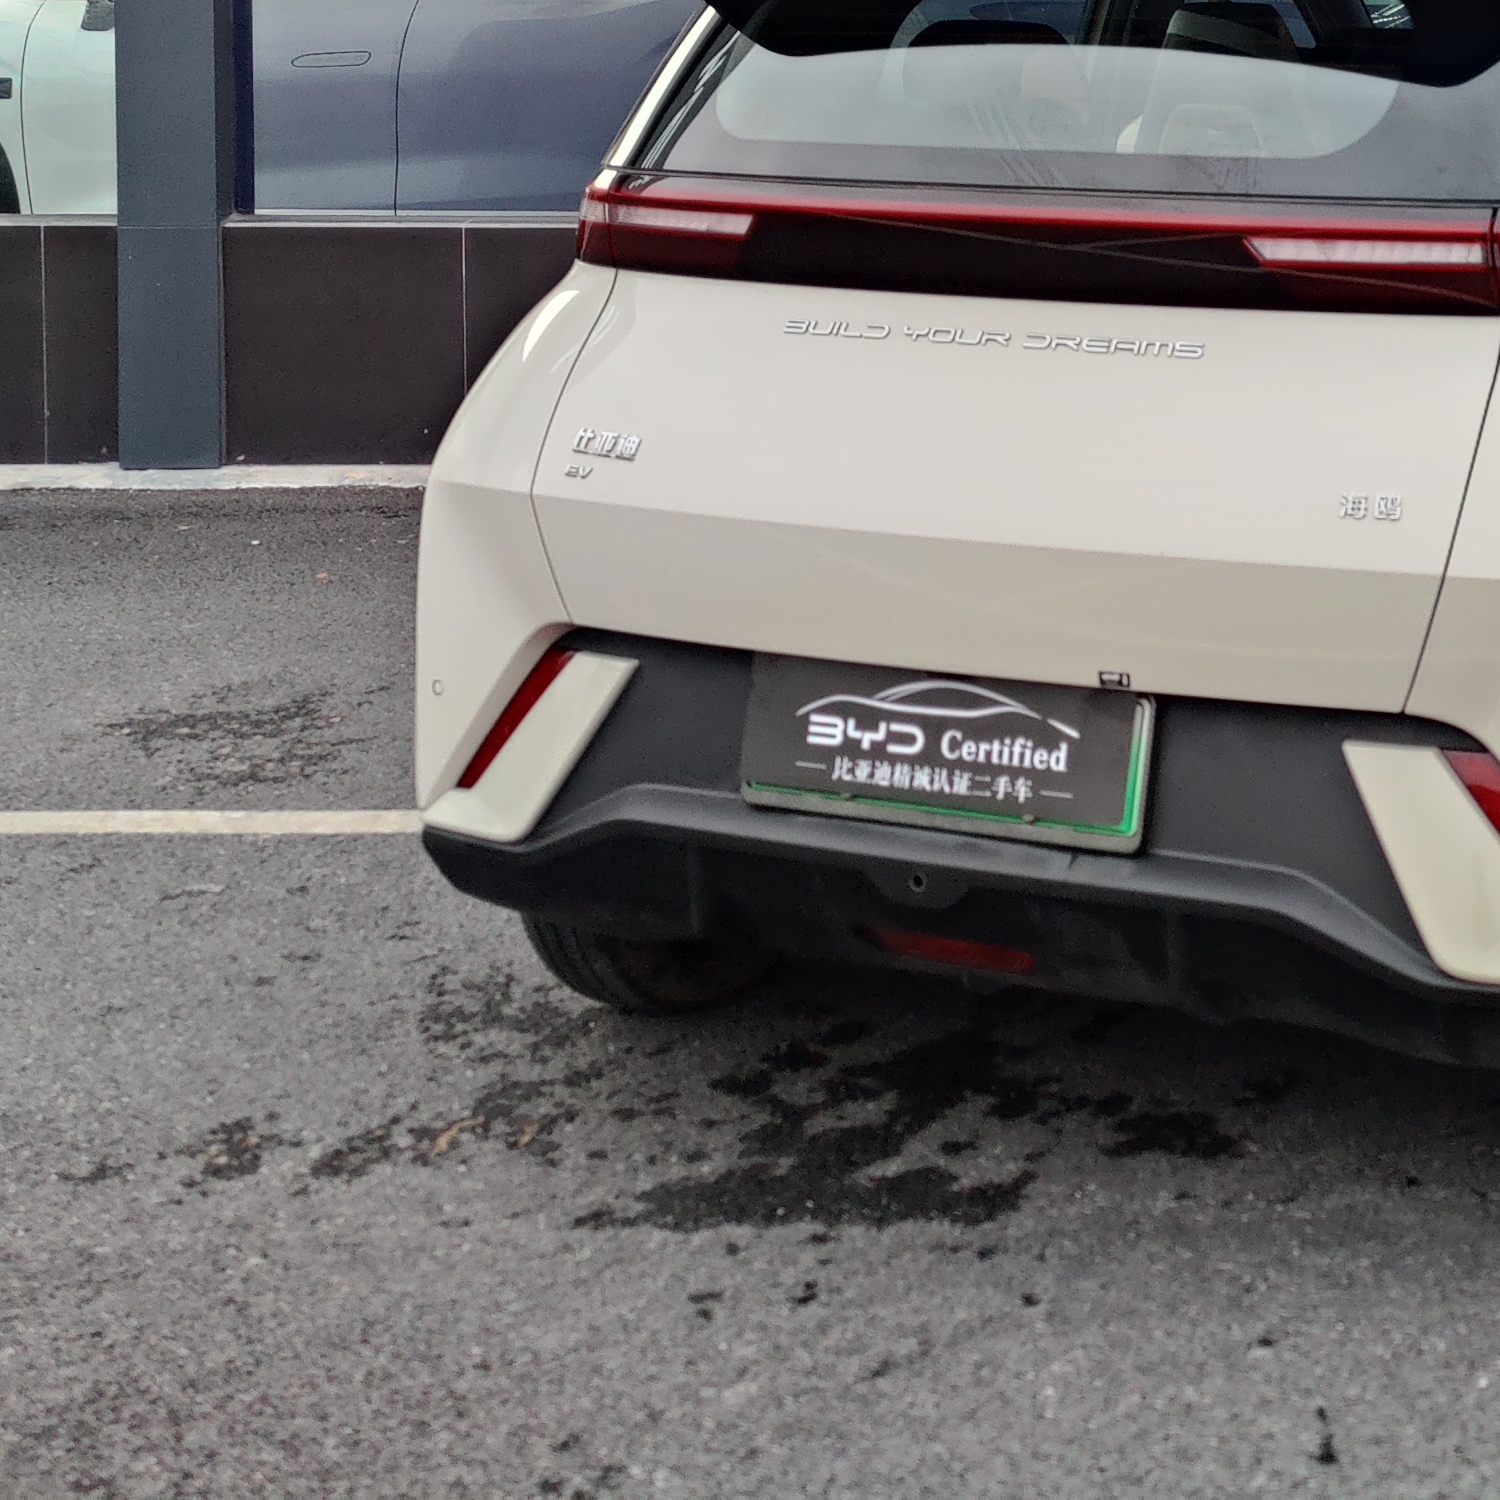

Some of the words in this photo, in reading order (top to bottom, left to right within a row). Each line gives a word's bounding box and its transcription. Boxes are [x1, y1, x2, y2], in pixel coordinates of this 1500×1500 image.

[783, 318, 891, 339] BUILD
[903, 325, 1012, 347] YOUR
[1022, 332, 1206, 359] DREAMS
[573, 427, 642, 461] 比亚迪
[1339, 491, 1402, 521] 海鸥
[807, 713, 926, 755] BYD
[940, 729, 1069, 773] Certified
[832, 755, 1034, 803] 比亚迪精诚认证二手车
